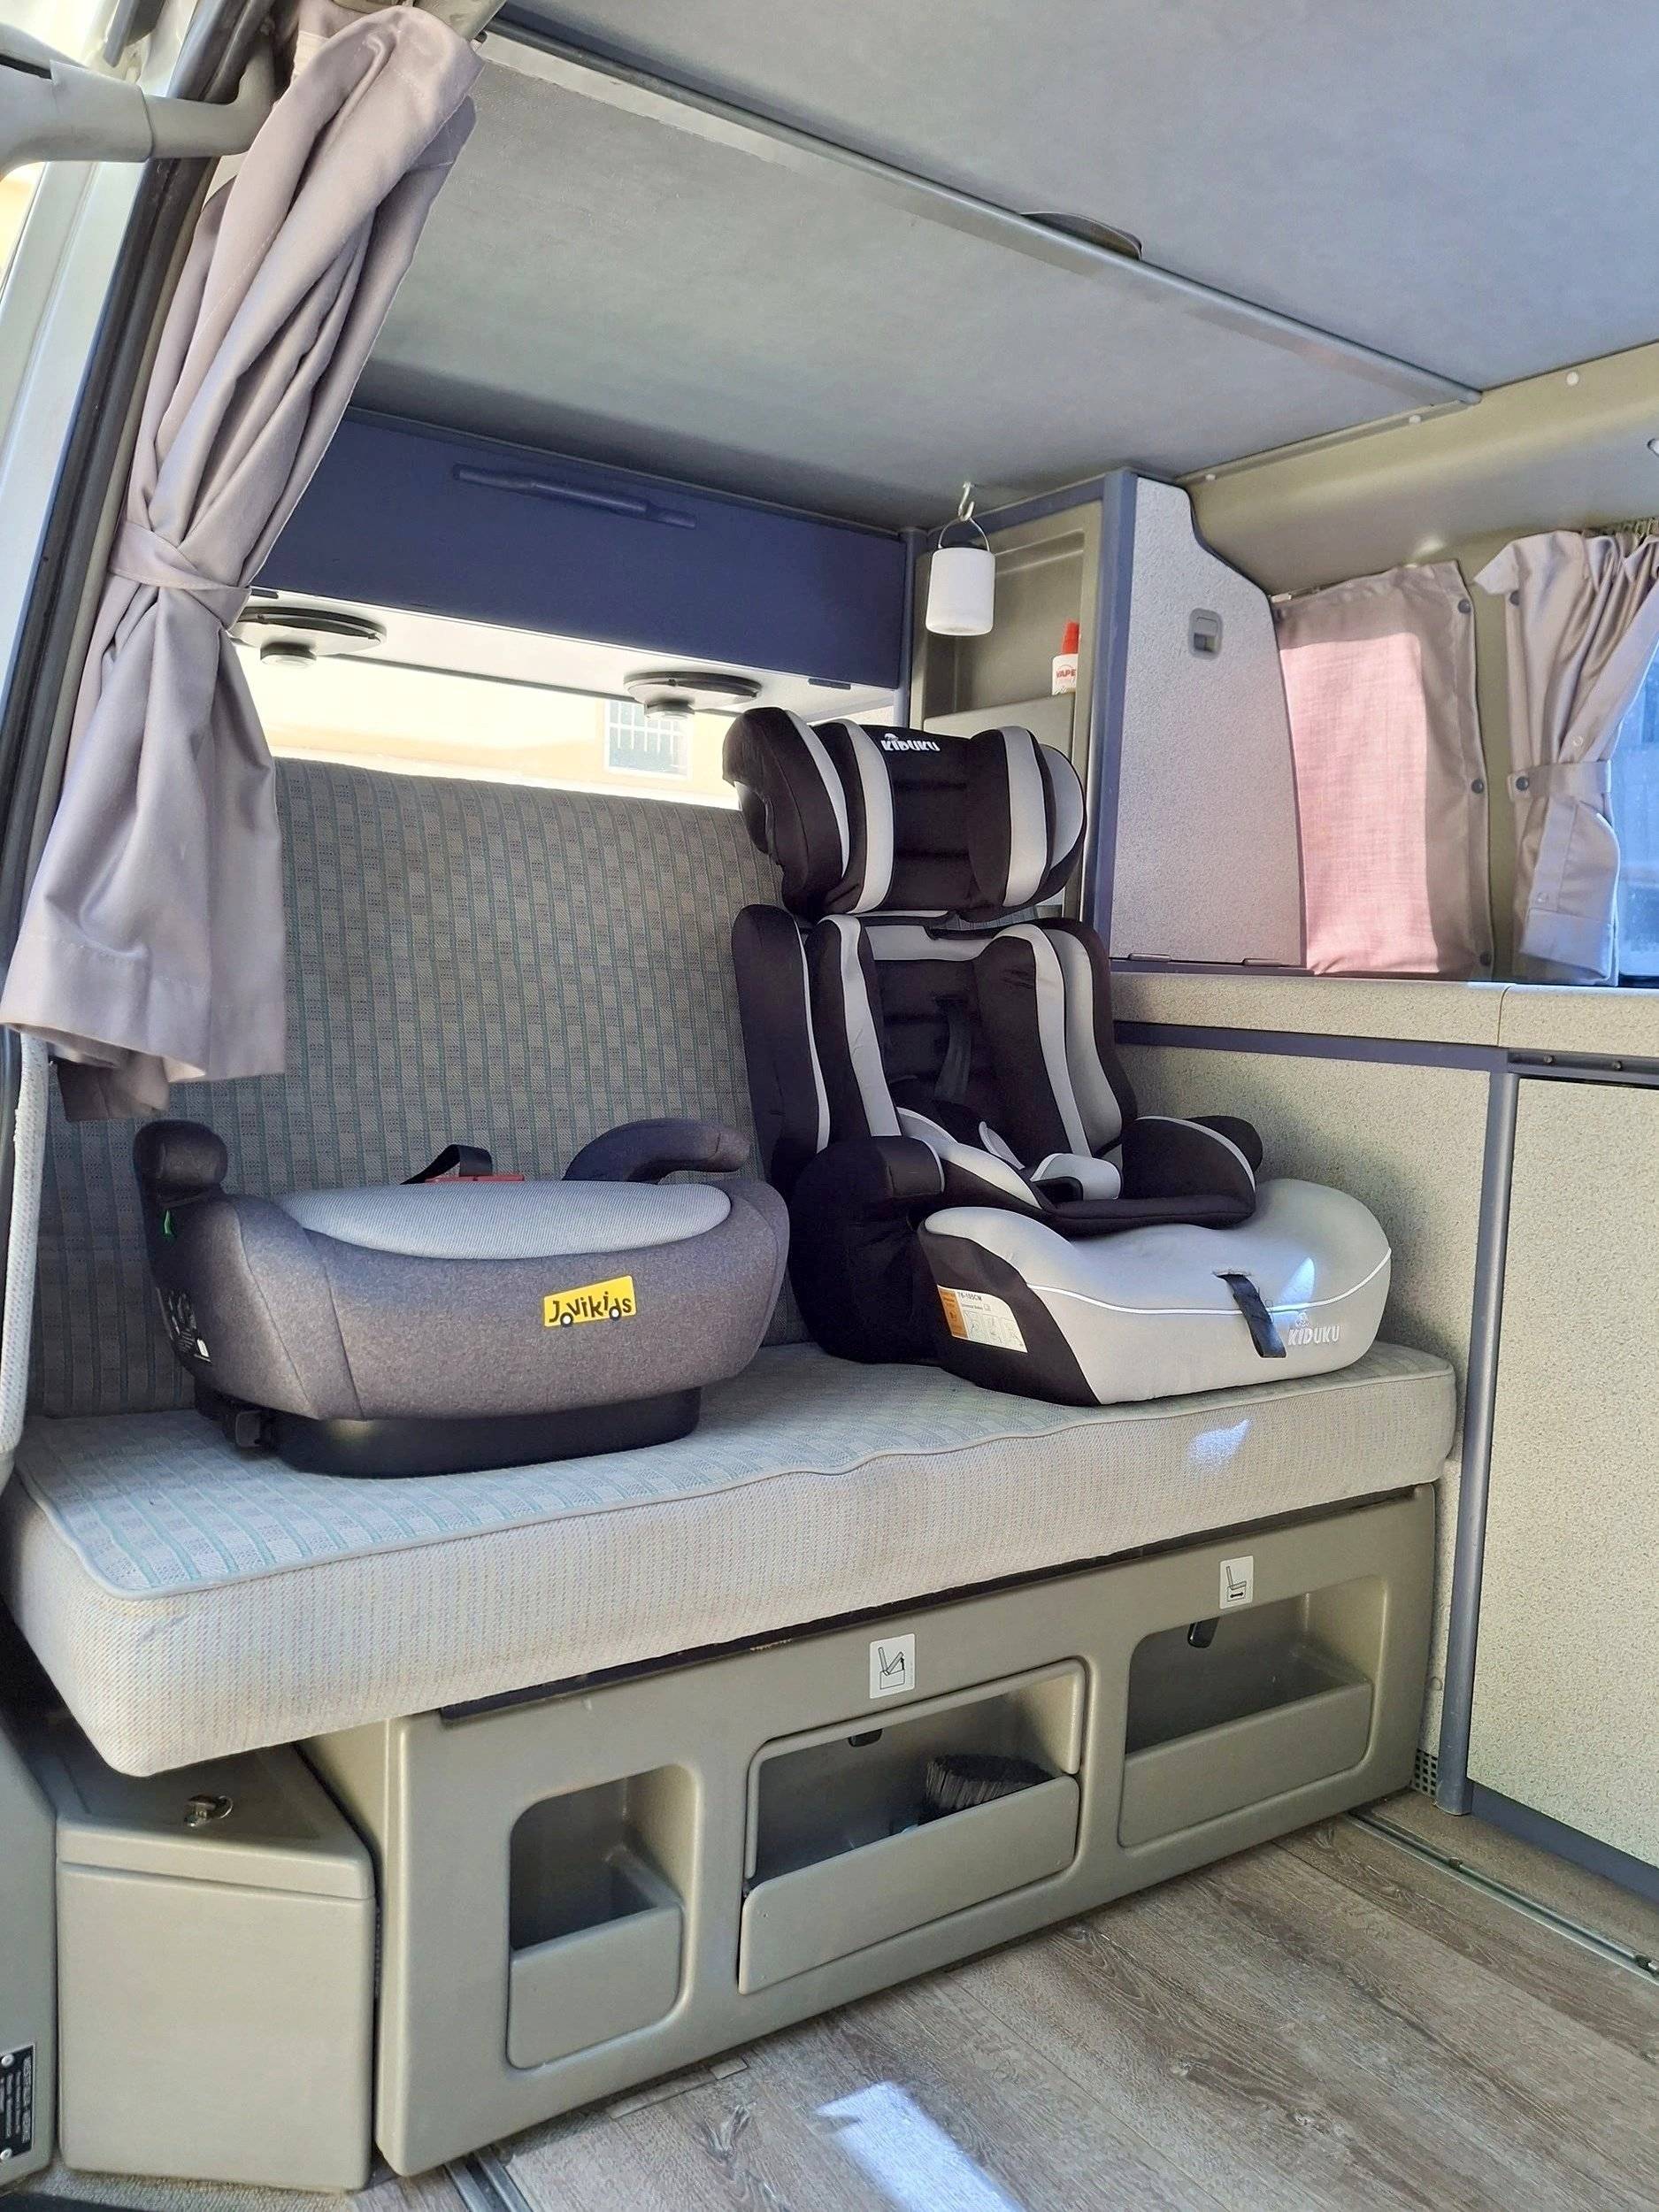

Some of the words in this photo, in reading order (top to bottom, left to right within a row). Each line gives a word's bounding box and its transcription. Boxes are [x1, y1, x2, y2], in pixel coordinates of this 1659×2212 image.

[1056, 668, 1077, 679] VAPE
[880, 740, 941, 751] KIDUKU
[1287, 1325, 1340, 1346] KIDUKU
